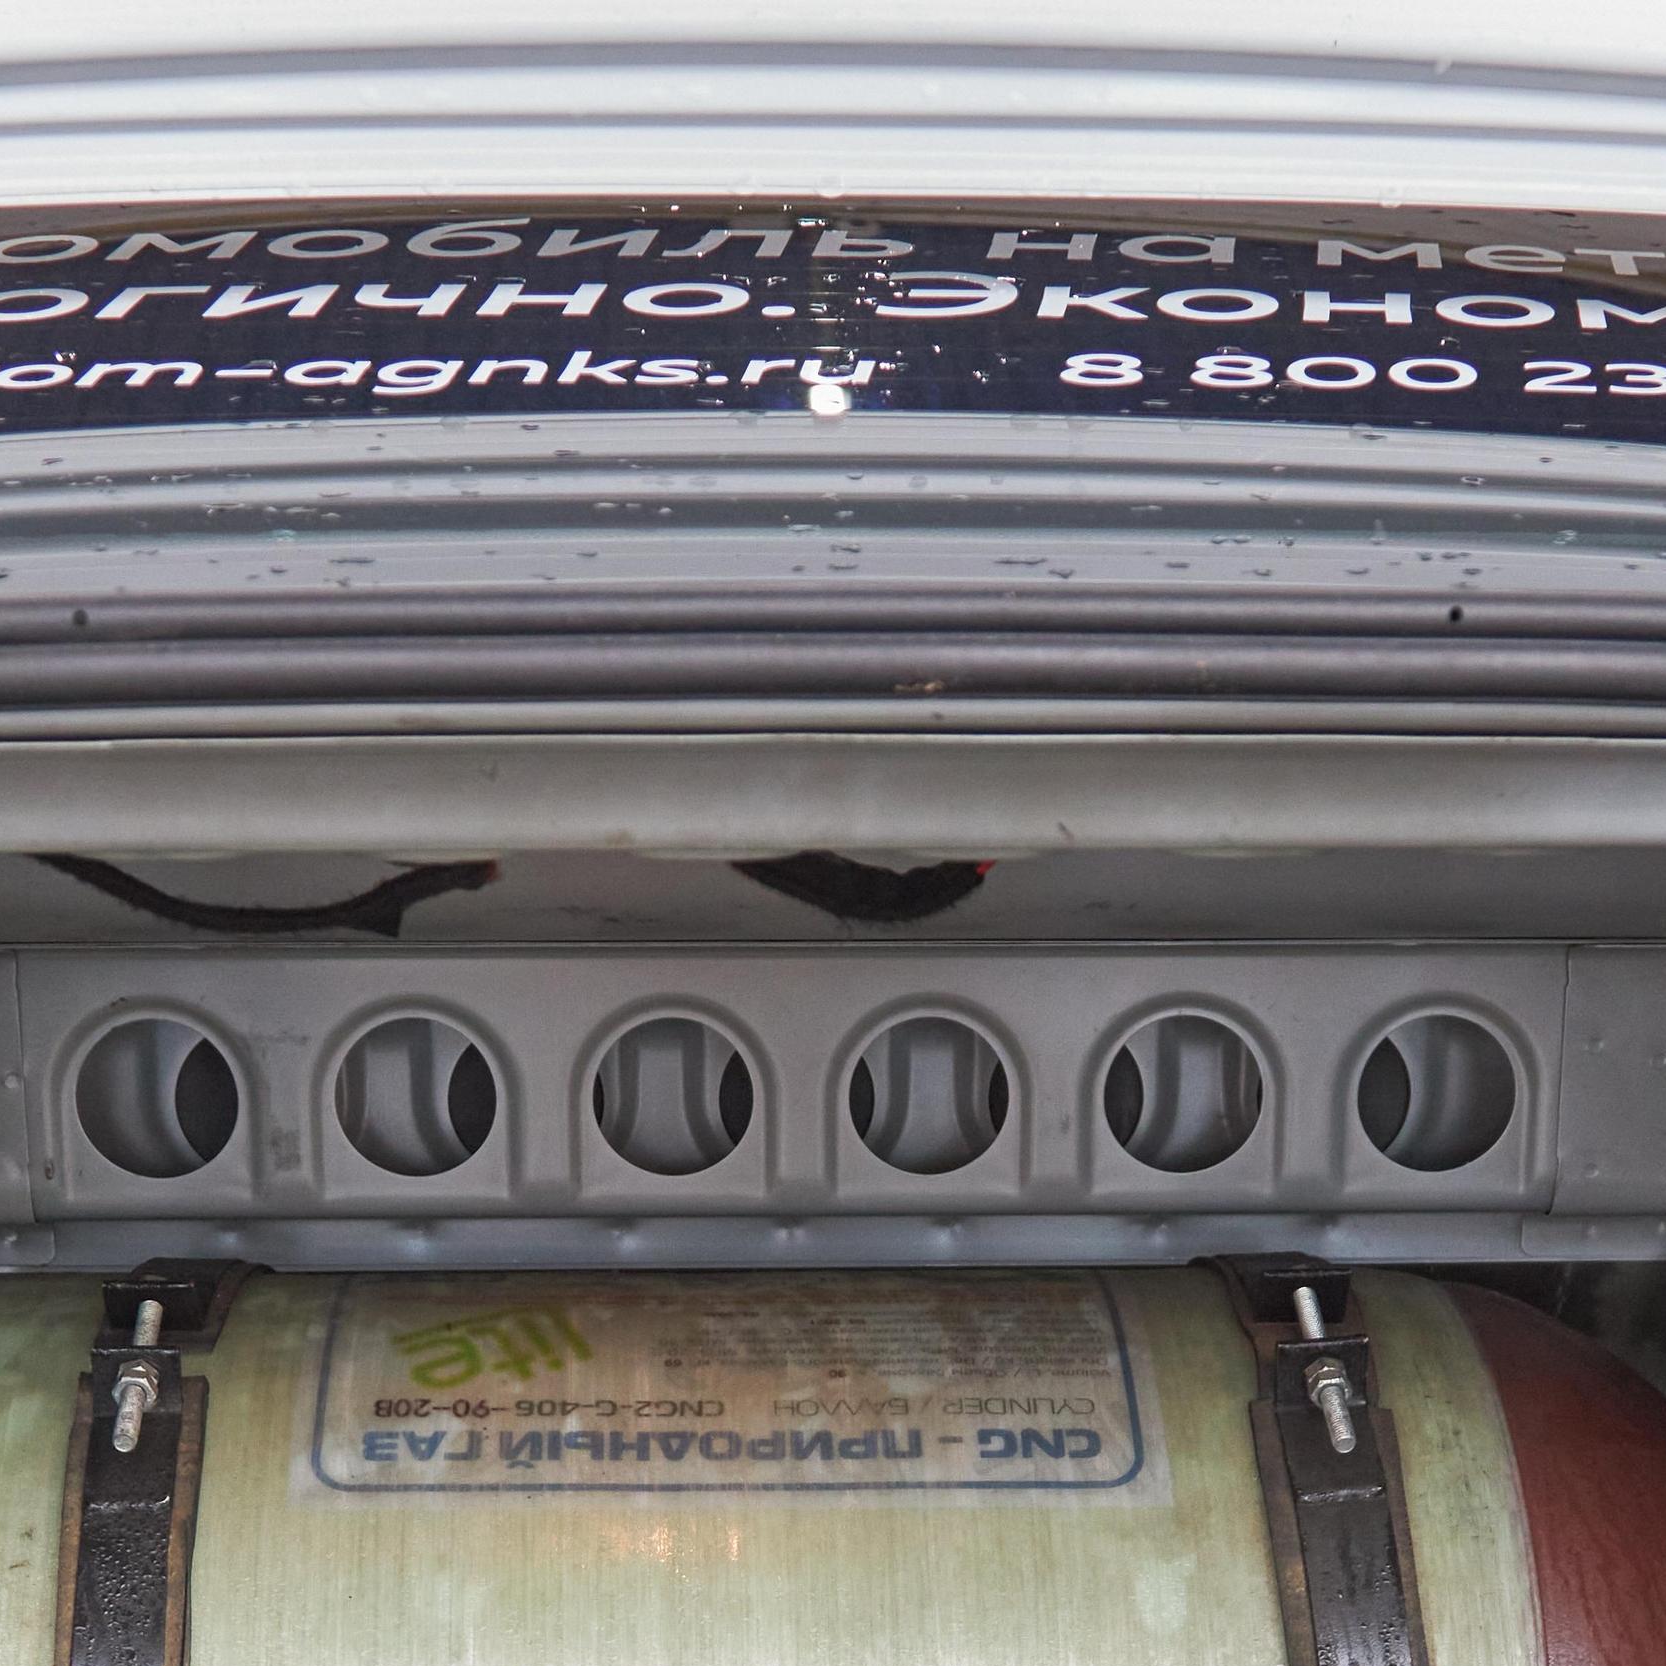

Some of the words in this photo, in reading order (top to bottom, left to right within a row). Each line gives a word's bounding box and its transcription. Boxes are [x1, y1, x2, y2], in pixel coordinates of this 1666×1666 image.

[985, 231, 1237, 265] на
[1059, 353, 1144, 388] 8
[1189, 353, 1479, 391] 800
[942, 1396, 1096, 1416] CYLINDER
[361, 1429, 483, 1462] ГАЗ
[499, 1427, 923, 1469] ПРИРОДНЫЙ
[977, 1427, 1102, 1460] CNG
